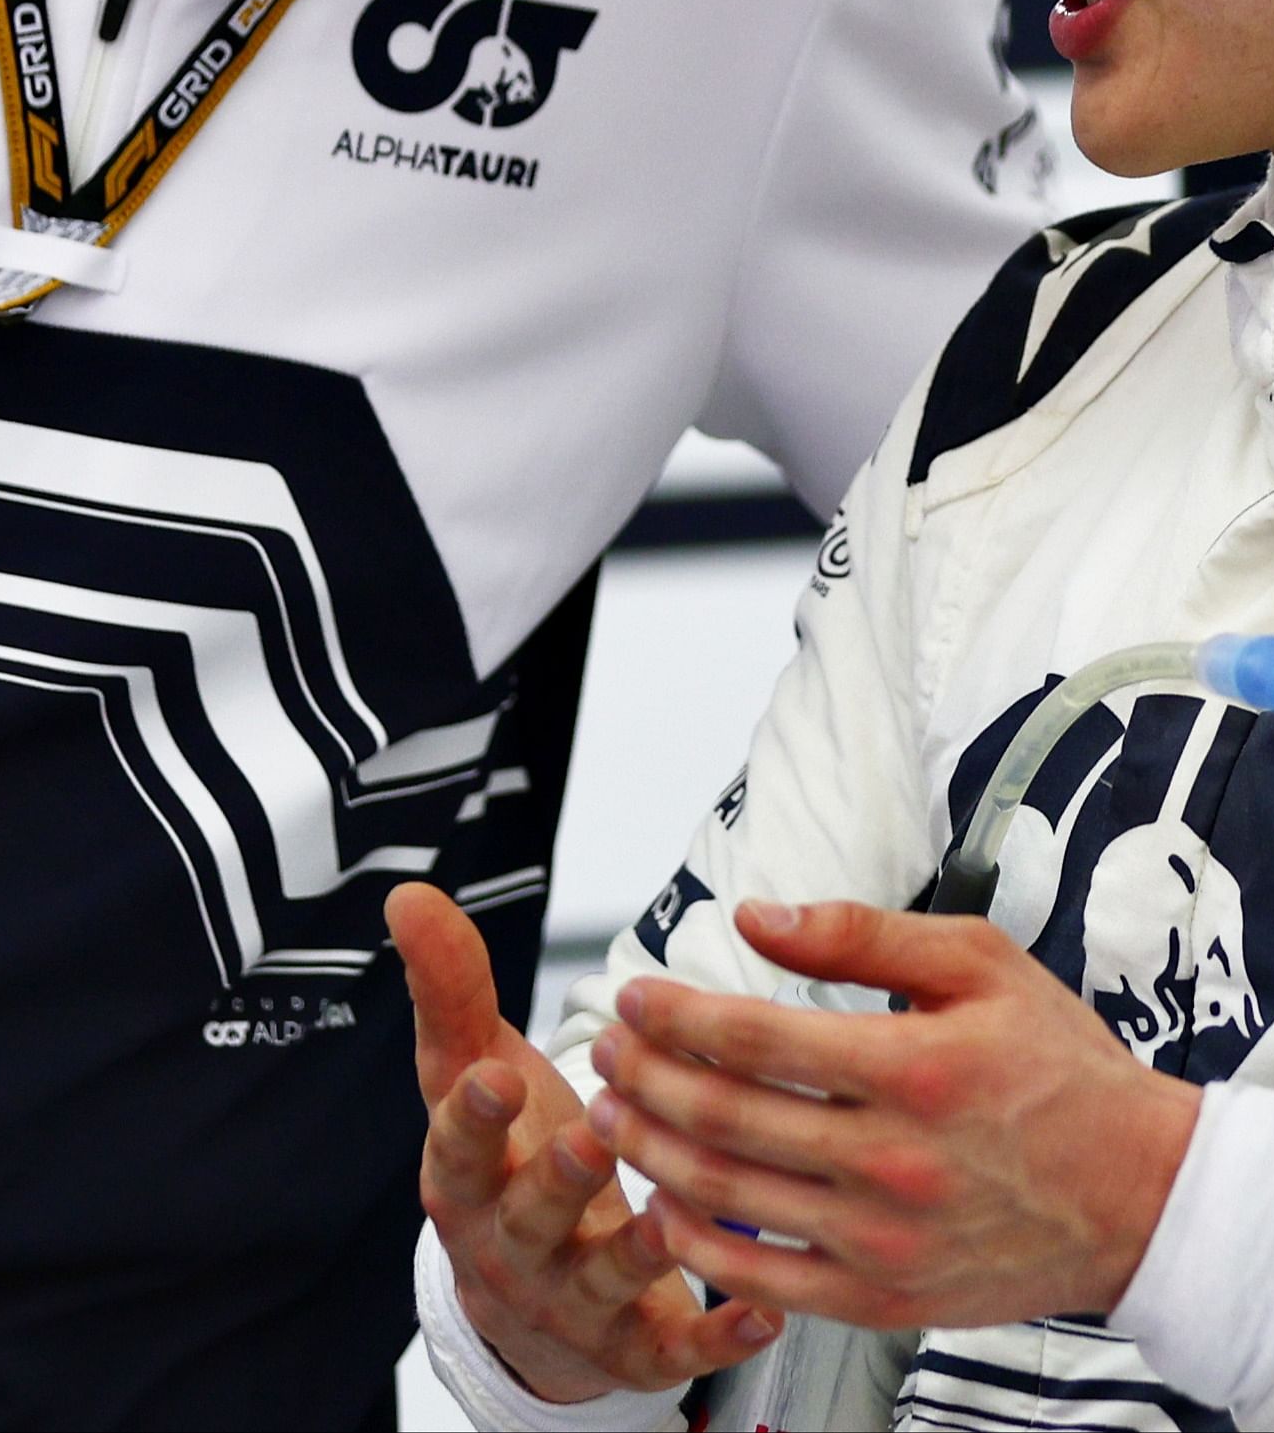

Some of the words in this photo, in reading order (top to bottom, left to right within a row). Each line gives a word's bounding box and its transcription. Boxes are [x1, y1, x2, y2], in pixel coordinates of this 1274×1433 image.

[13, 2, 55, 109] GRID
[157, 37, 235, 130] GRID
[331, 127, 540, 190] ALPHATAURI
